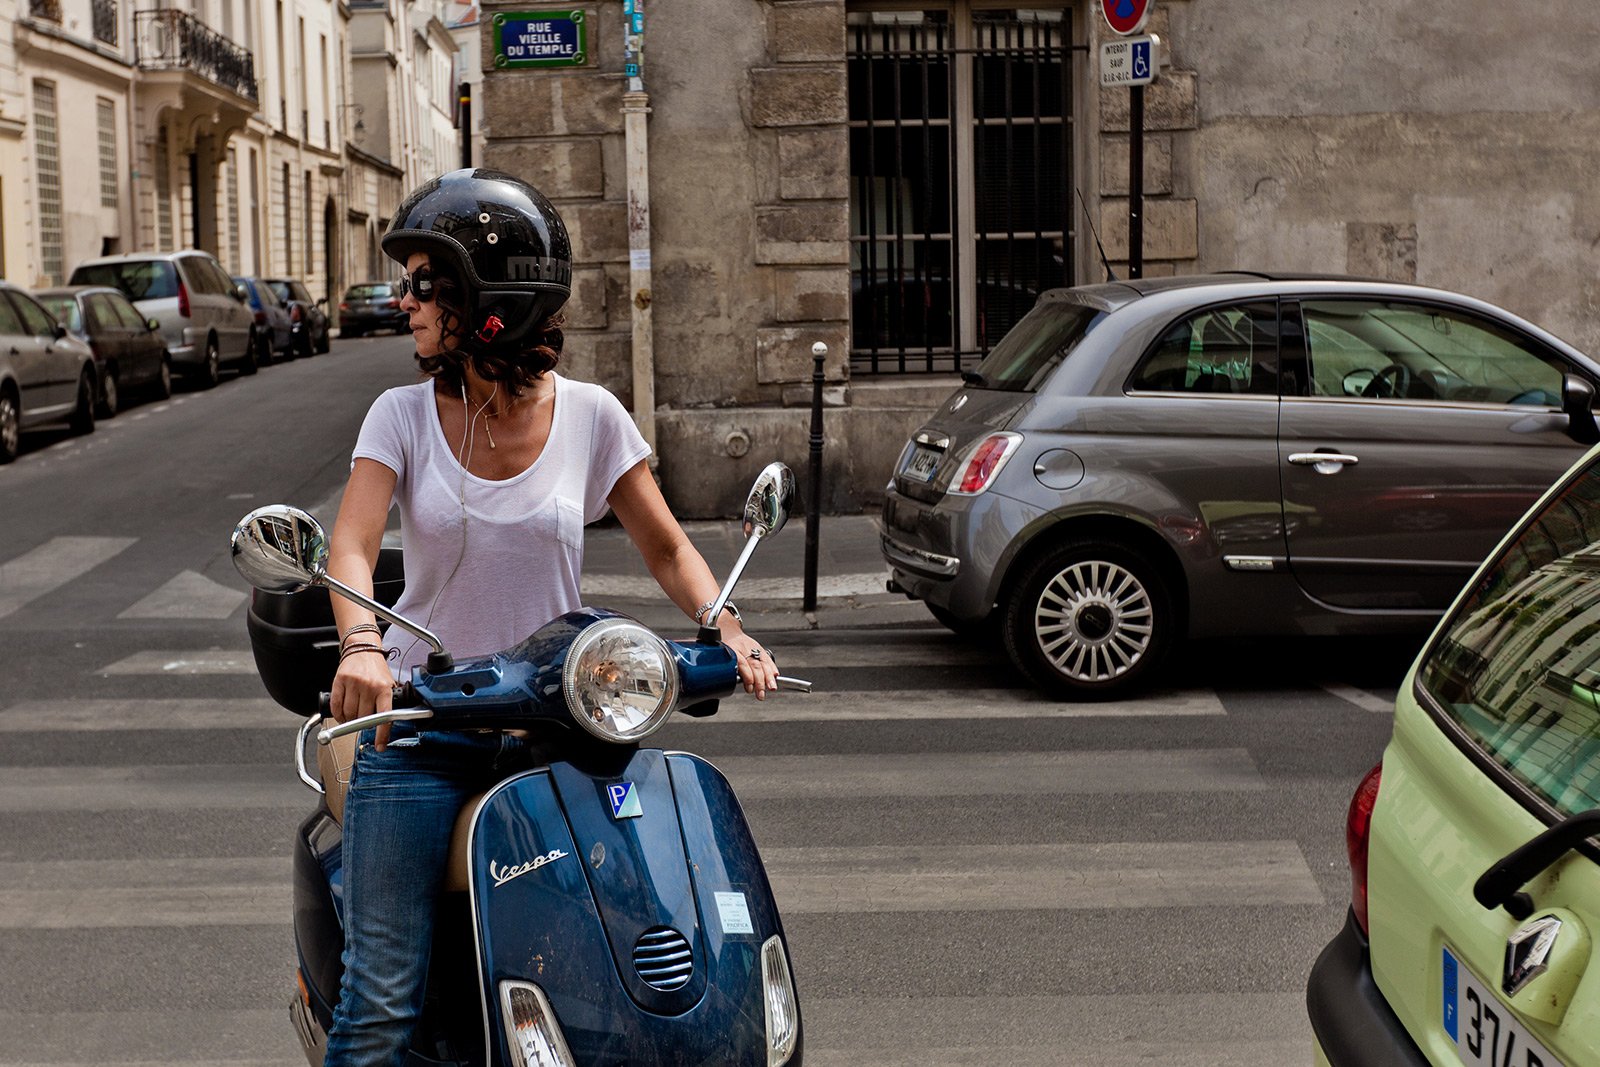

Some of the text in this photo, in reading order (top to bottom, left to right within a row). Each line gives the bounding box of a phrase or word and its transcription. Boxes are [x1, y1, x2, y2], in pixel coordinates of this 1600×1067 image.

[527, 22, 552, 32] RUE
[518, 33, 561, 44] VIEILLE
[507, 44, 573, 56] DU TEMPLE
[1105, 44, 1128, 55] INTERDIT
[1110, 58, 1124, 69] SAUF
[609, 785, 626, 806] P
[489, 849, 568, 888] Vespa
